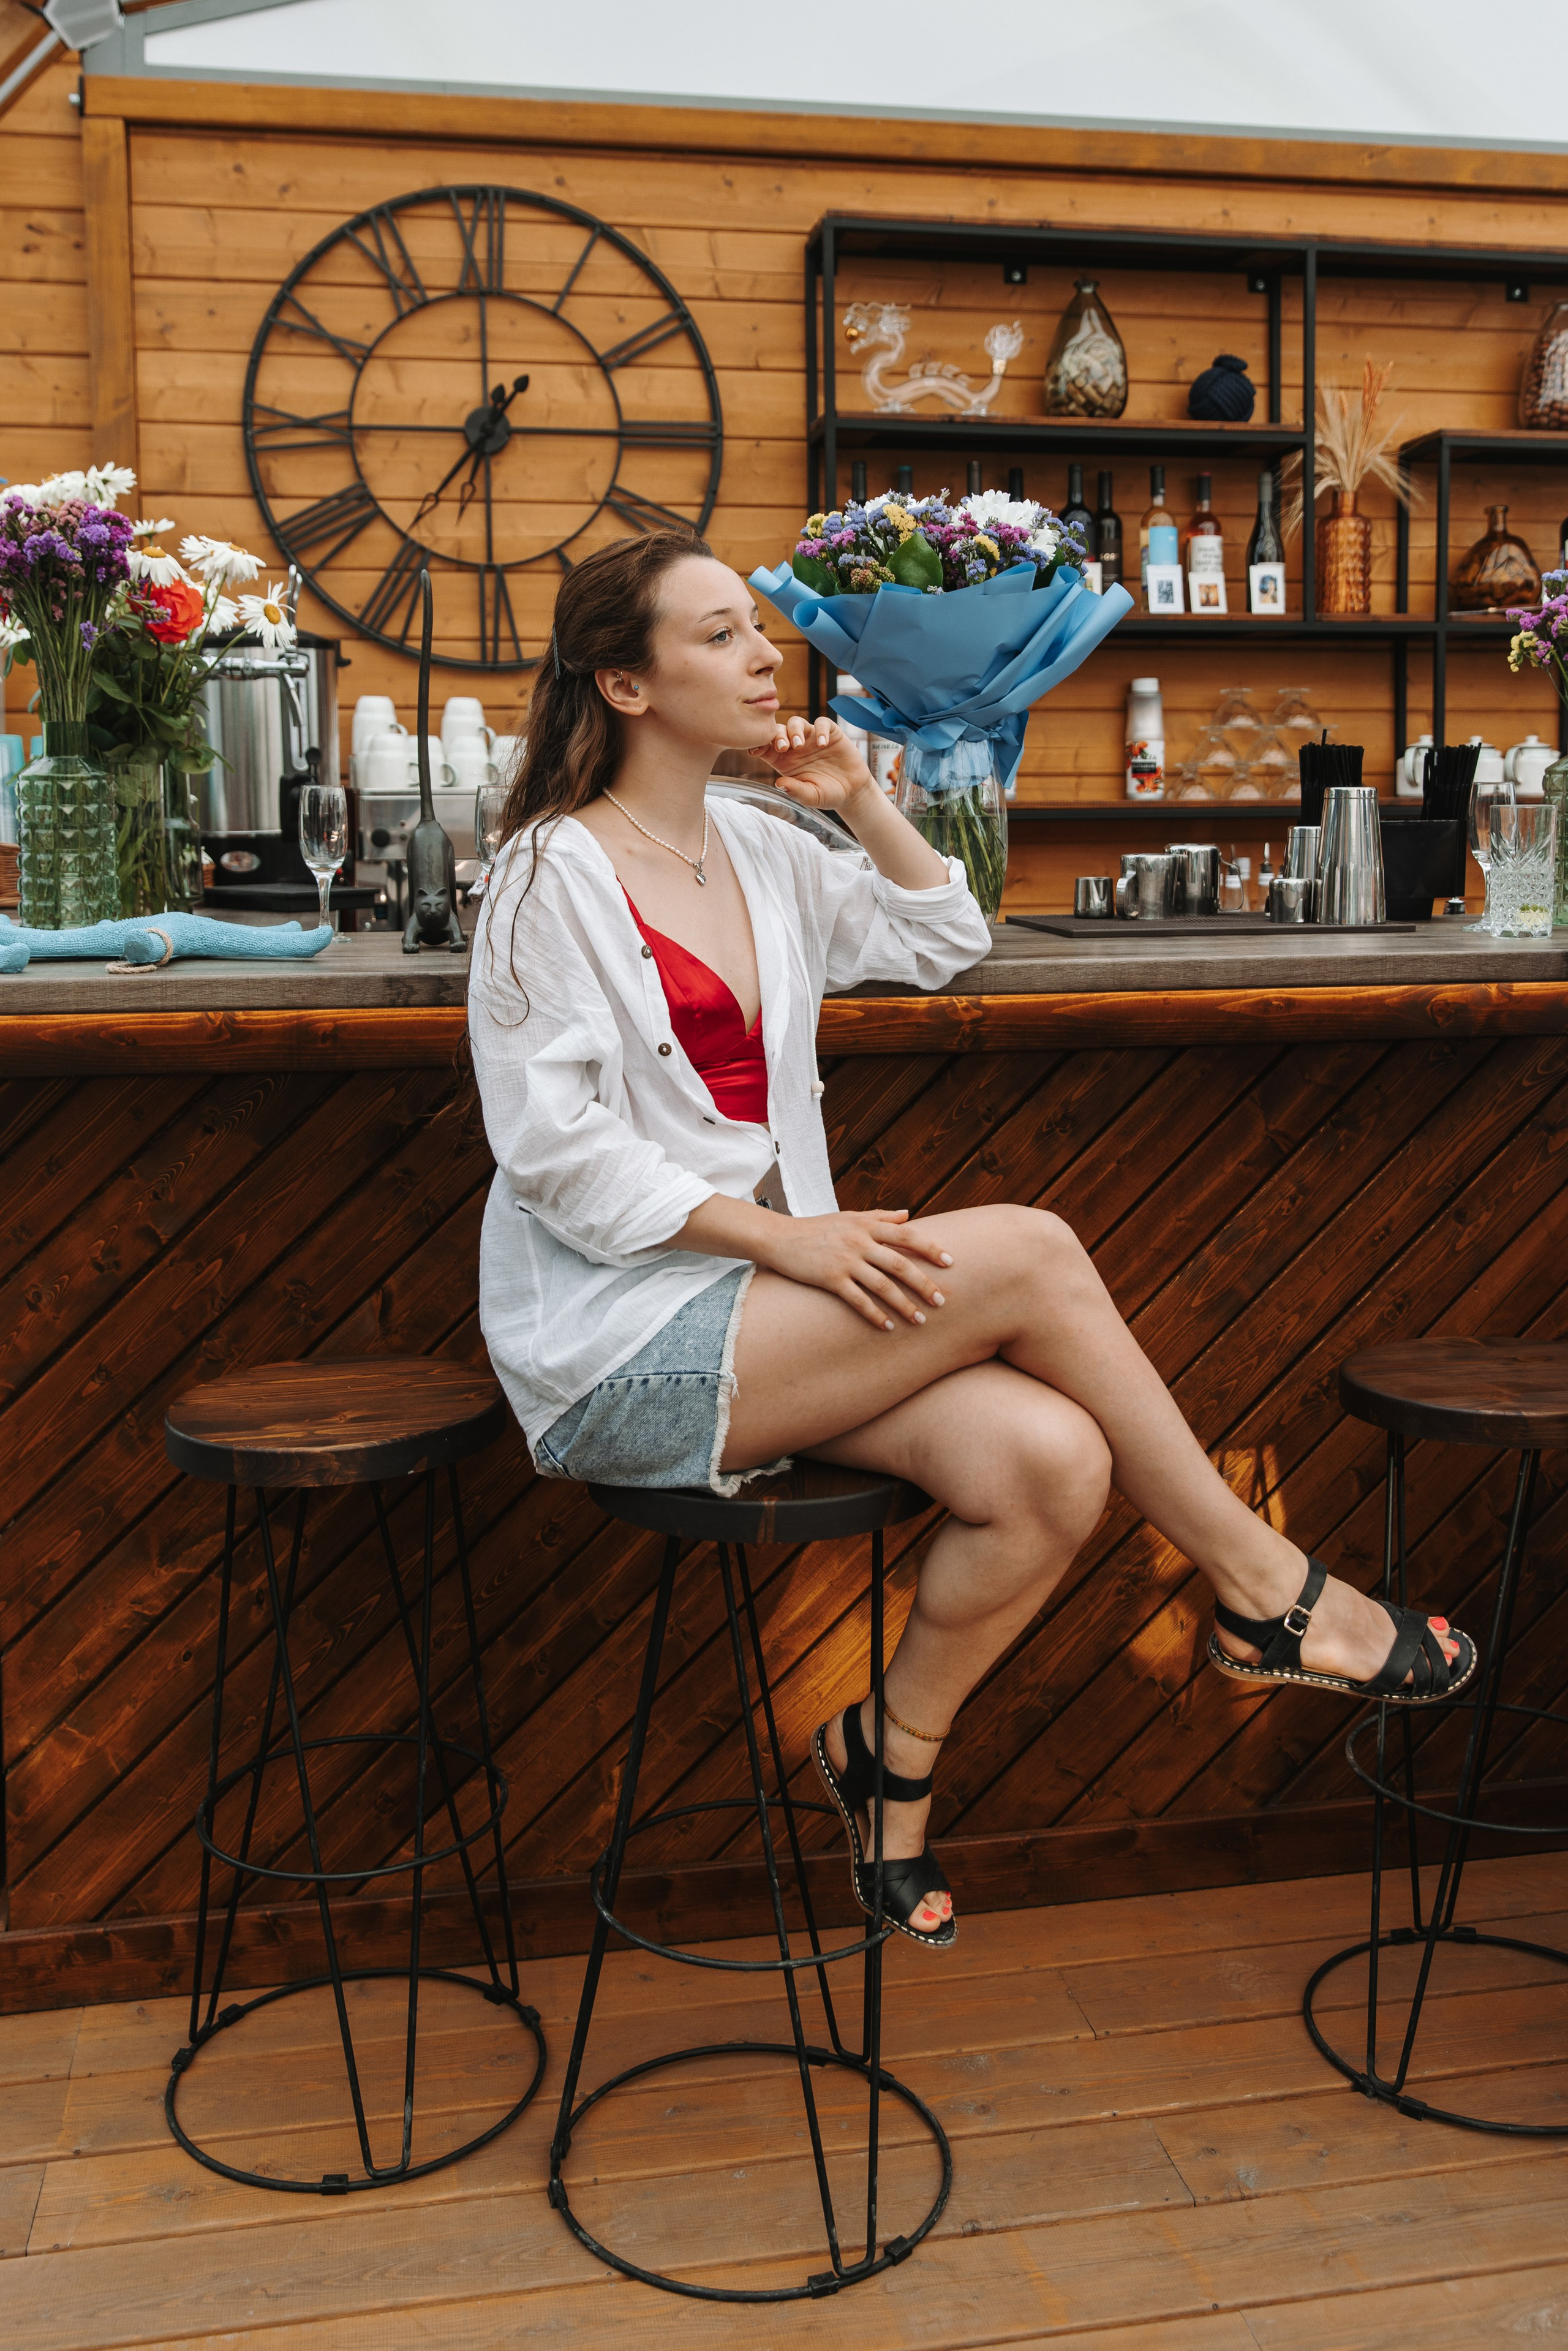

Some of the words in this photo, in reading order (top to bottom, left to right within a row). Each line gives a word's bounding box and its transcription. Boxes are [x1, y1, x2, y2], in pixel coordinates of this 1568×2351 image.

[344, 206, 428, 316] XI
[450, 189, 505, 293] XII
[554, 227, 600, 314] I
[270, 290, 369, 369] X
[600, 309, 691, 371] II
[251, 401, 350, 451] IX
[620, 420, 718, 448] III
[276, 481, 380, 575] VIII
[360, 539, 430, 644] VII
[479, 565, 523, 661] VI
